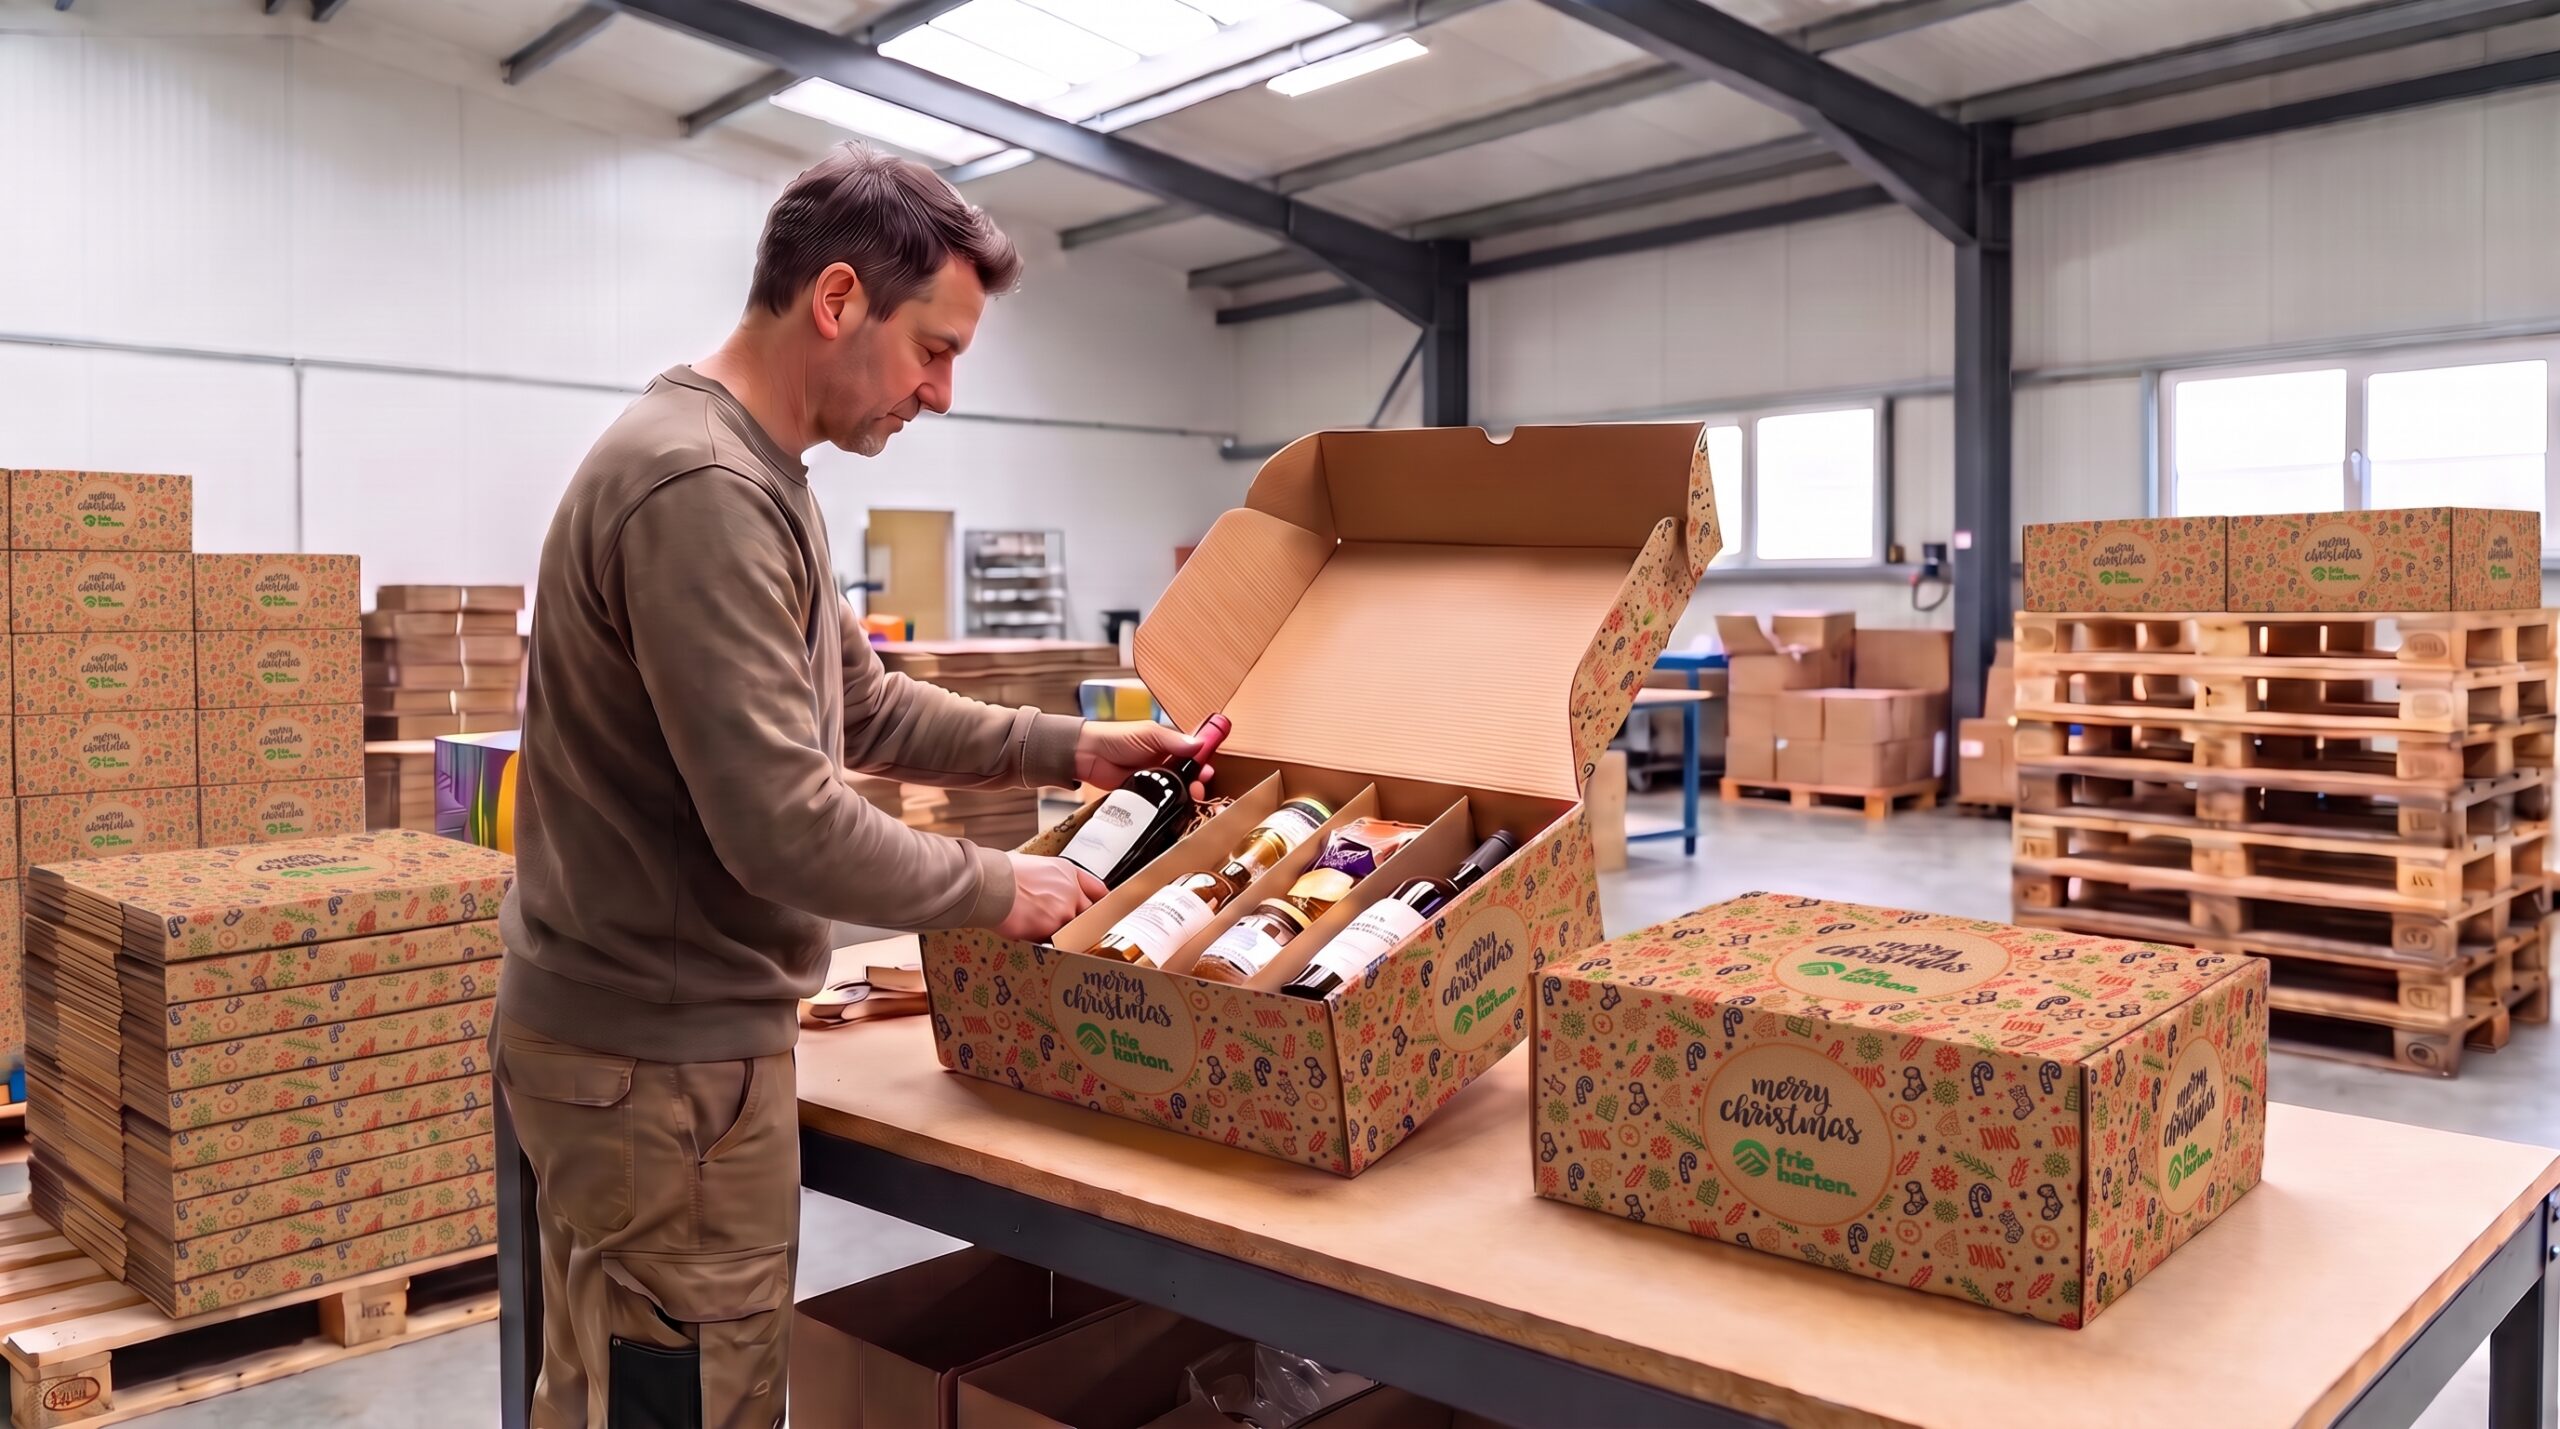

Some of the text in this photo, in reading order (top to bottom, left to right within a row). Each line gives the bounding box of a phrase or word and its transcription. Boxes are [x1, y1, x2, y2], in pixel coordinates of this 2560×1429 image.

[1063, 984, 1173, 1027] christmas
[1082, 970, 1148, 1003] merry
[1752, 1076, 1832, 1116] merry
[1720, 1094, 1862, 1145] christmas
[1775, 1147, 1814, 1171] frie
